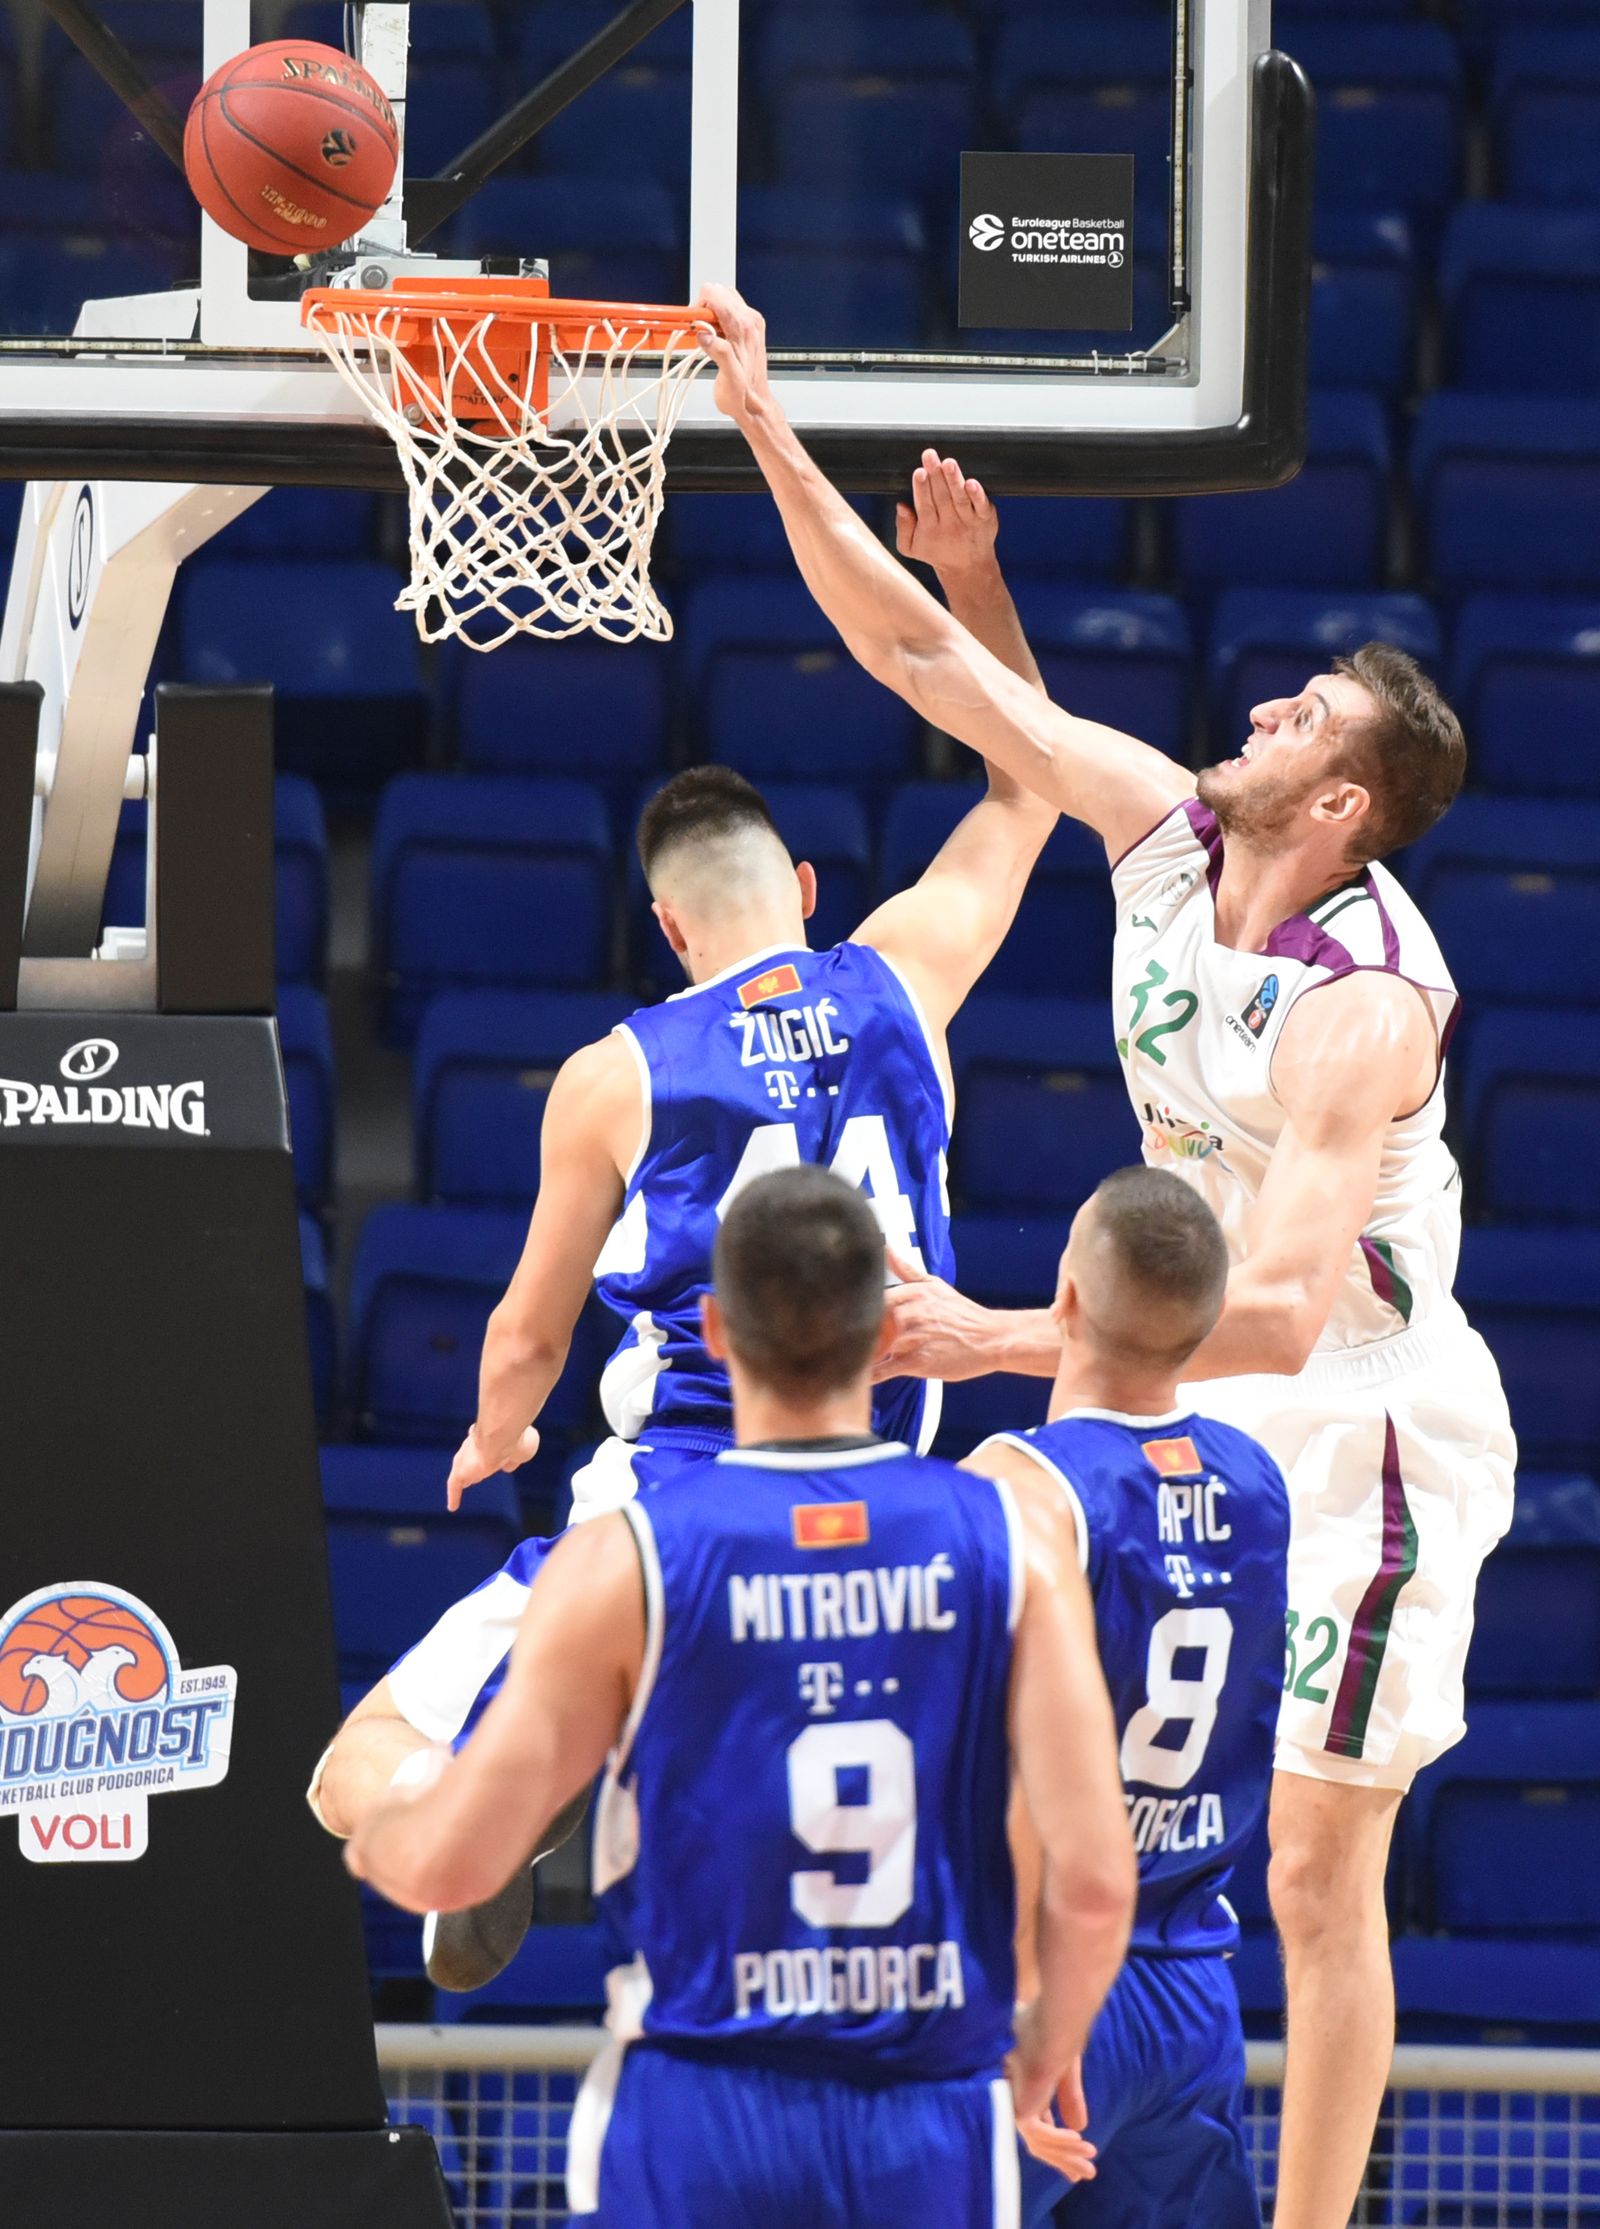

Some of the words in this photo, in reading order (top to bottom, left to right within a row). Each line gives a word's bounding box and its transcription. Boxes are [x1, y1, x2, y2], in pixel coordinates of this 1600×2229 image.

[1011, 228, 1124, 250] oneteam
[1012, 217, 1071, 230] Euroleague
[1073, 218, 1124, 229] Basketball
[1012, 253, 1058, 263] TURKISH
[1060, 254, 1106, 264] AIRLINES
[729, 998, 849, 1067] ŽUGIĆ
[0, 1078, 205, 1136] PALDING
[728, 1553, 957, 1643] MITROVIĆ
[1120, 1606, 1234, 1790] 8
[0, 1700, 222, 1780] DUĆNOST
[0, 1783, 55, 1805] KETBALL
[60, 1778, 94, 1797] CLUB
[97, 1767, 175, 1792] PODGORICA
[30, 1813, 131, 1850] VOLI
[786, 1718, 918, 1929] 9
